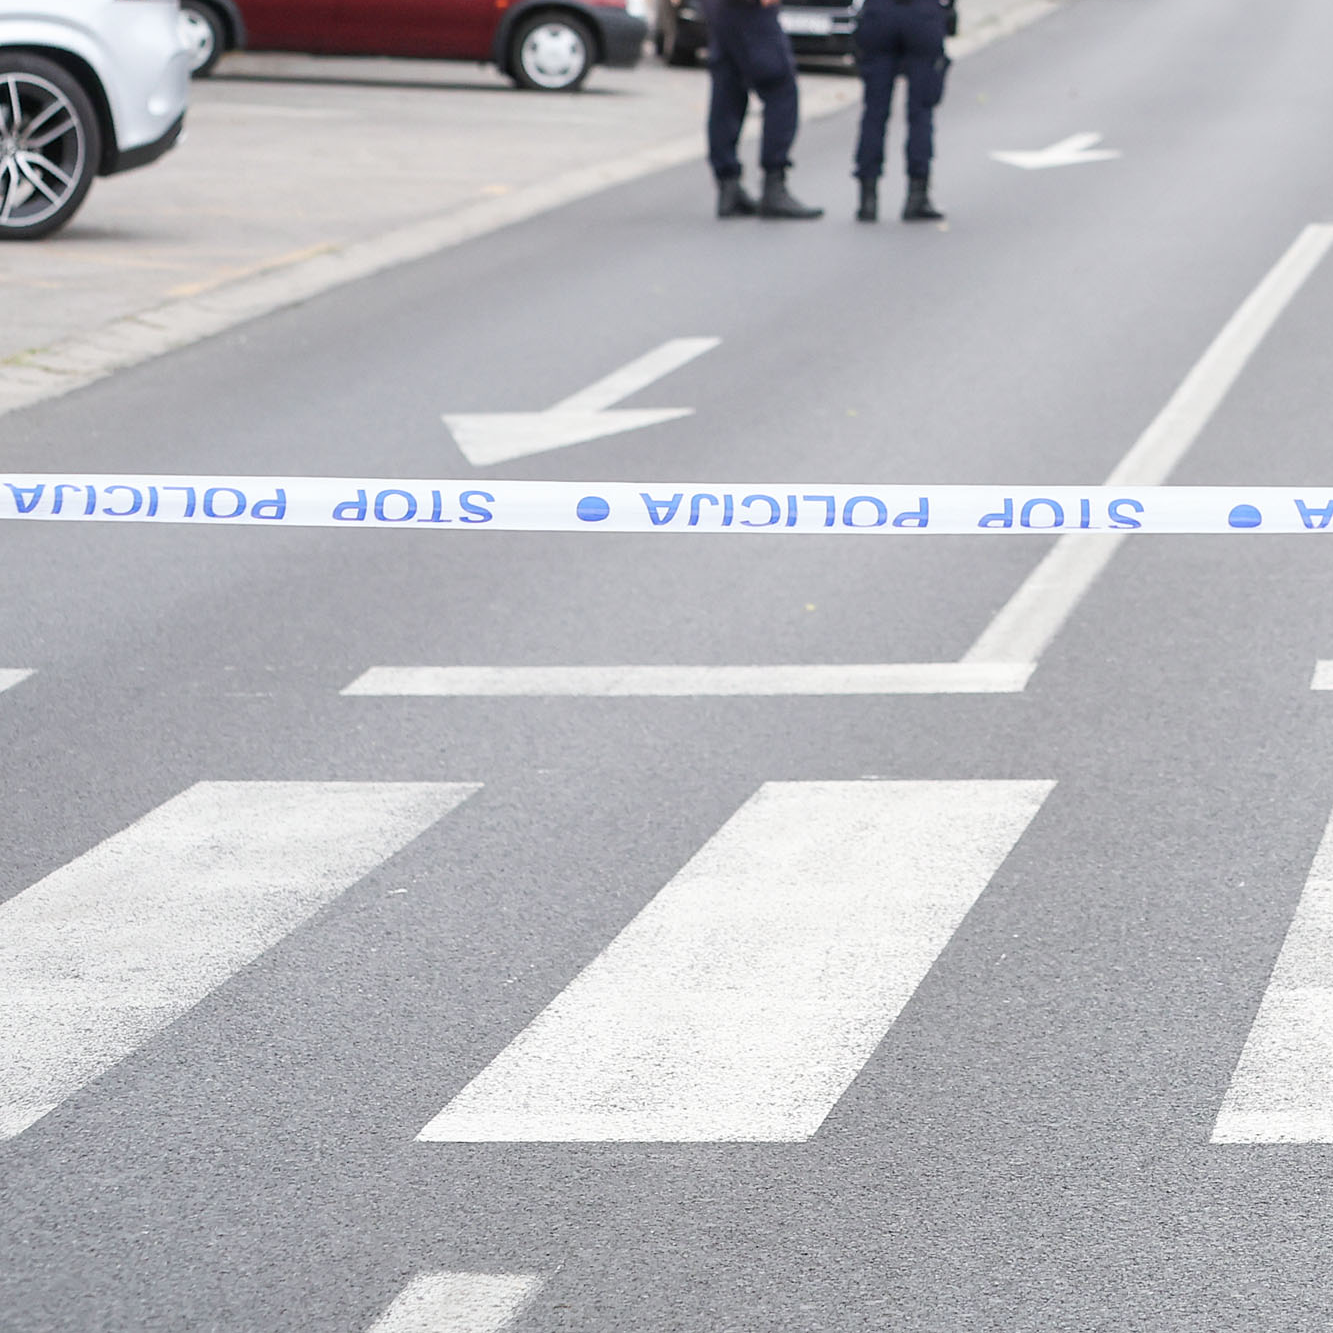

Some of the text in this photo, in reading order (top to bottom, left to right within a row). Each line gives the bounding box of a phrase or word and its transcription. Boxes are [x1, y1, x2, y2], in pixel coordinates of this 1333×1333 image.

[4, 483, 496, 524] STOP POLICIJA
[640, 493, 1146, 530] STOP POLICIJA
